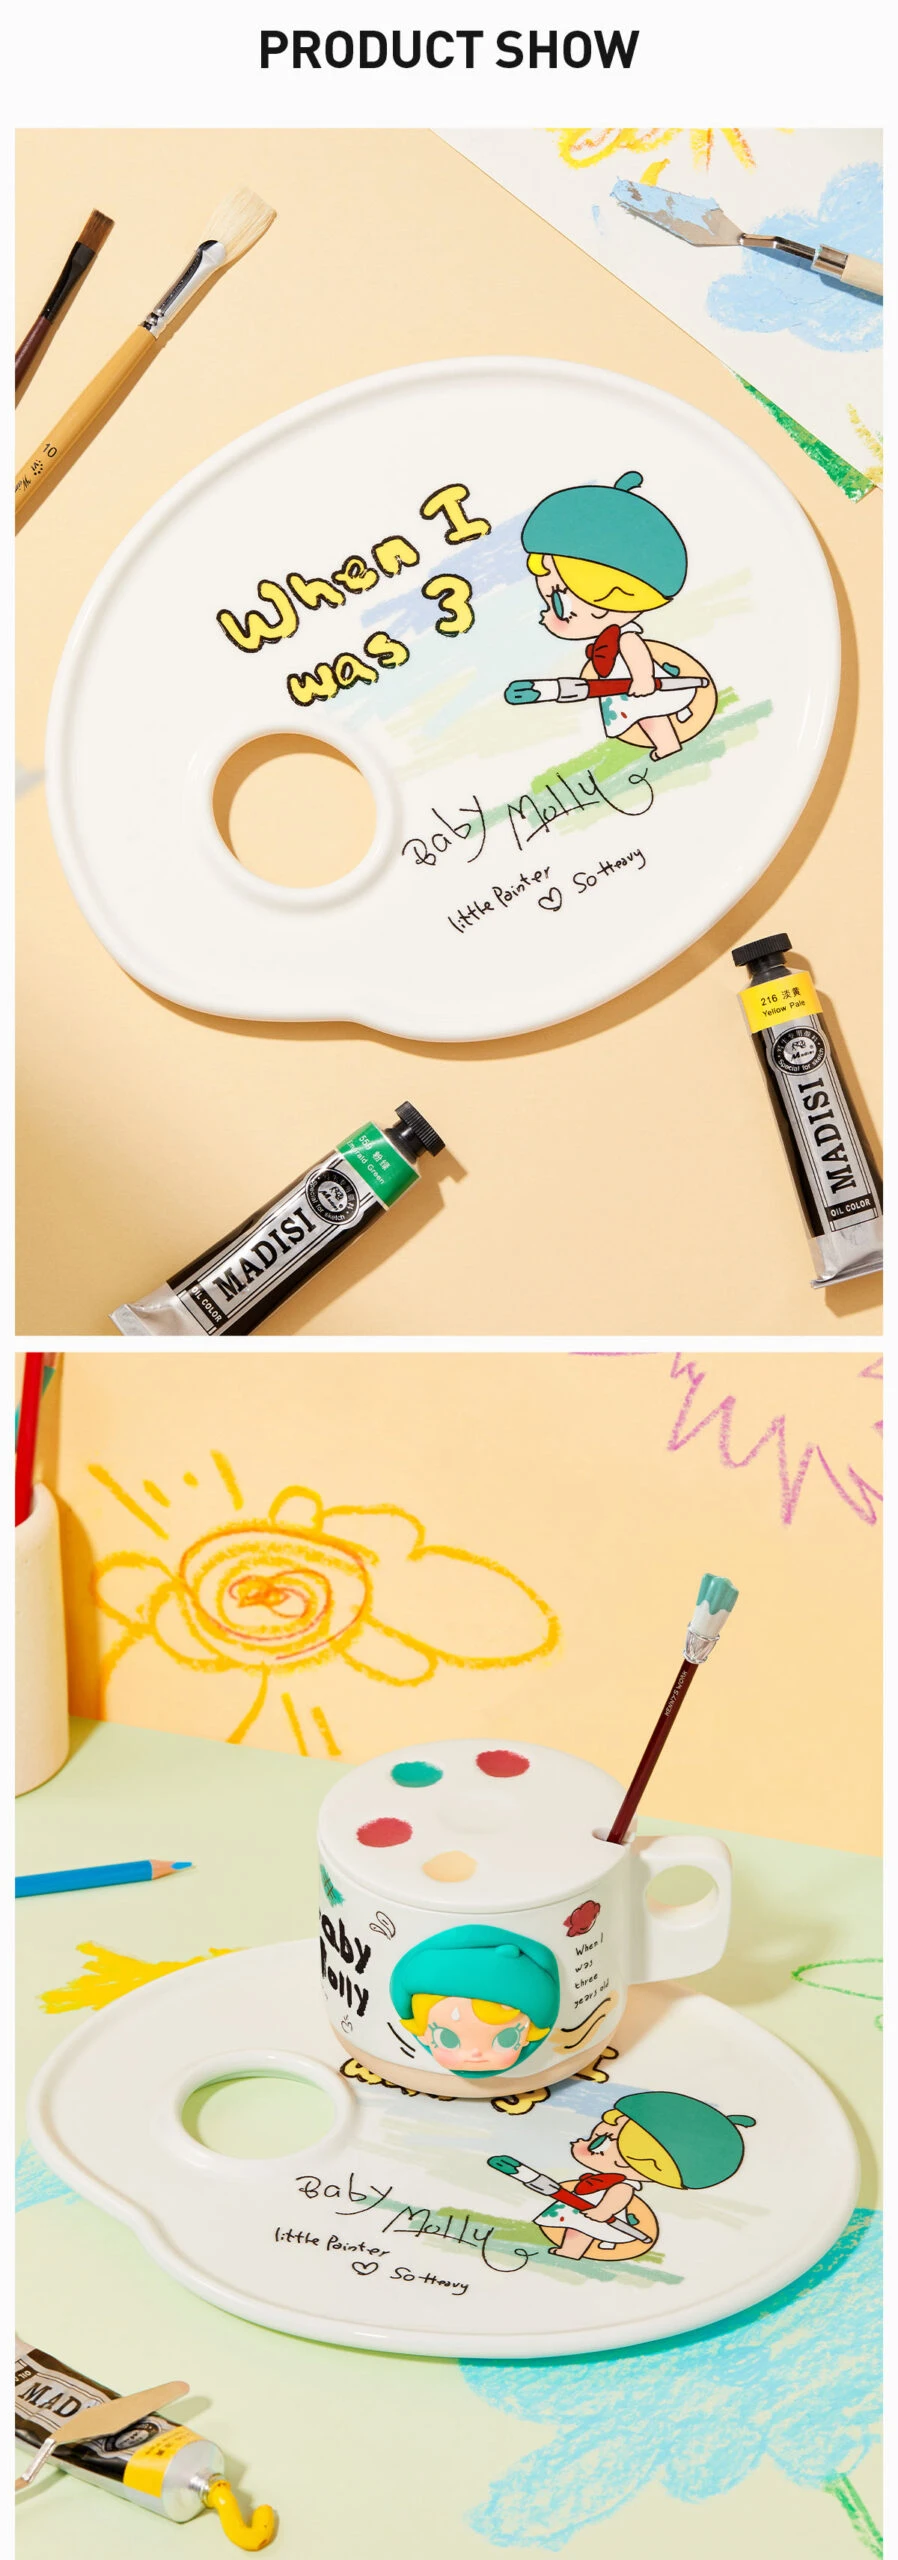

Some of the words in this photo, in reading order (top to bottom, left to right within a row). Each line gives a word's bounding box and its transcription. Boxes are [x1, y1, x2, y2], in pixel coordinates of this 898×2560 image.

[216, 535, 420, 654] When
[420, 483, 492, 545] I
[287, 631, 410, 707] was
[422, 574, 475, 637] 3
[402, 795, 486, 865] Baby
[507, 768, 654, 851] Molly
[493, 866, 550, 907] Painter
[761, 994, 778, 1006] 216
[762, 1006, 787, 1018] Yellow
[789, 1000, 806, 1009] Pale
[798, 1078, 857, 1194] MADISI
[367, 1164, 385, 1184] Green
[830, 1208, 845, 1217] OIL
[845, 1198, 871, 1213] COLOR
[212, 1207, 317, 1302] MADISI
[191, 1286, 203, 1299] OIL
[201, 1299, 223, 1322] COLOR
[319, 1907, 371, 1975] aby
[575, 1940, 598, 1956] When
[574, 1973, 598, 1989] three
[575, 1960, 593, 1973] was
[574, 1989, 597, 2009] years
[599, 1978, 610, 1992] old
[296, 2173, 393, 2215] Baby
[382, 2205, 539, 2273] Molly
[326, 2234, 390, 2257] Painter
[18, 2382, 91, 2417] MAD
